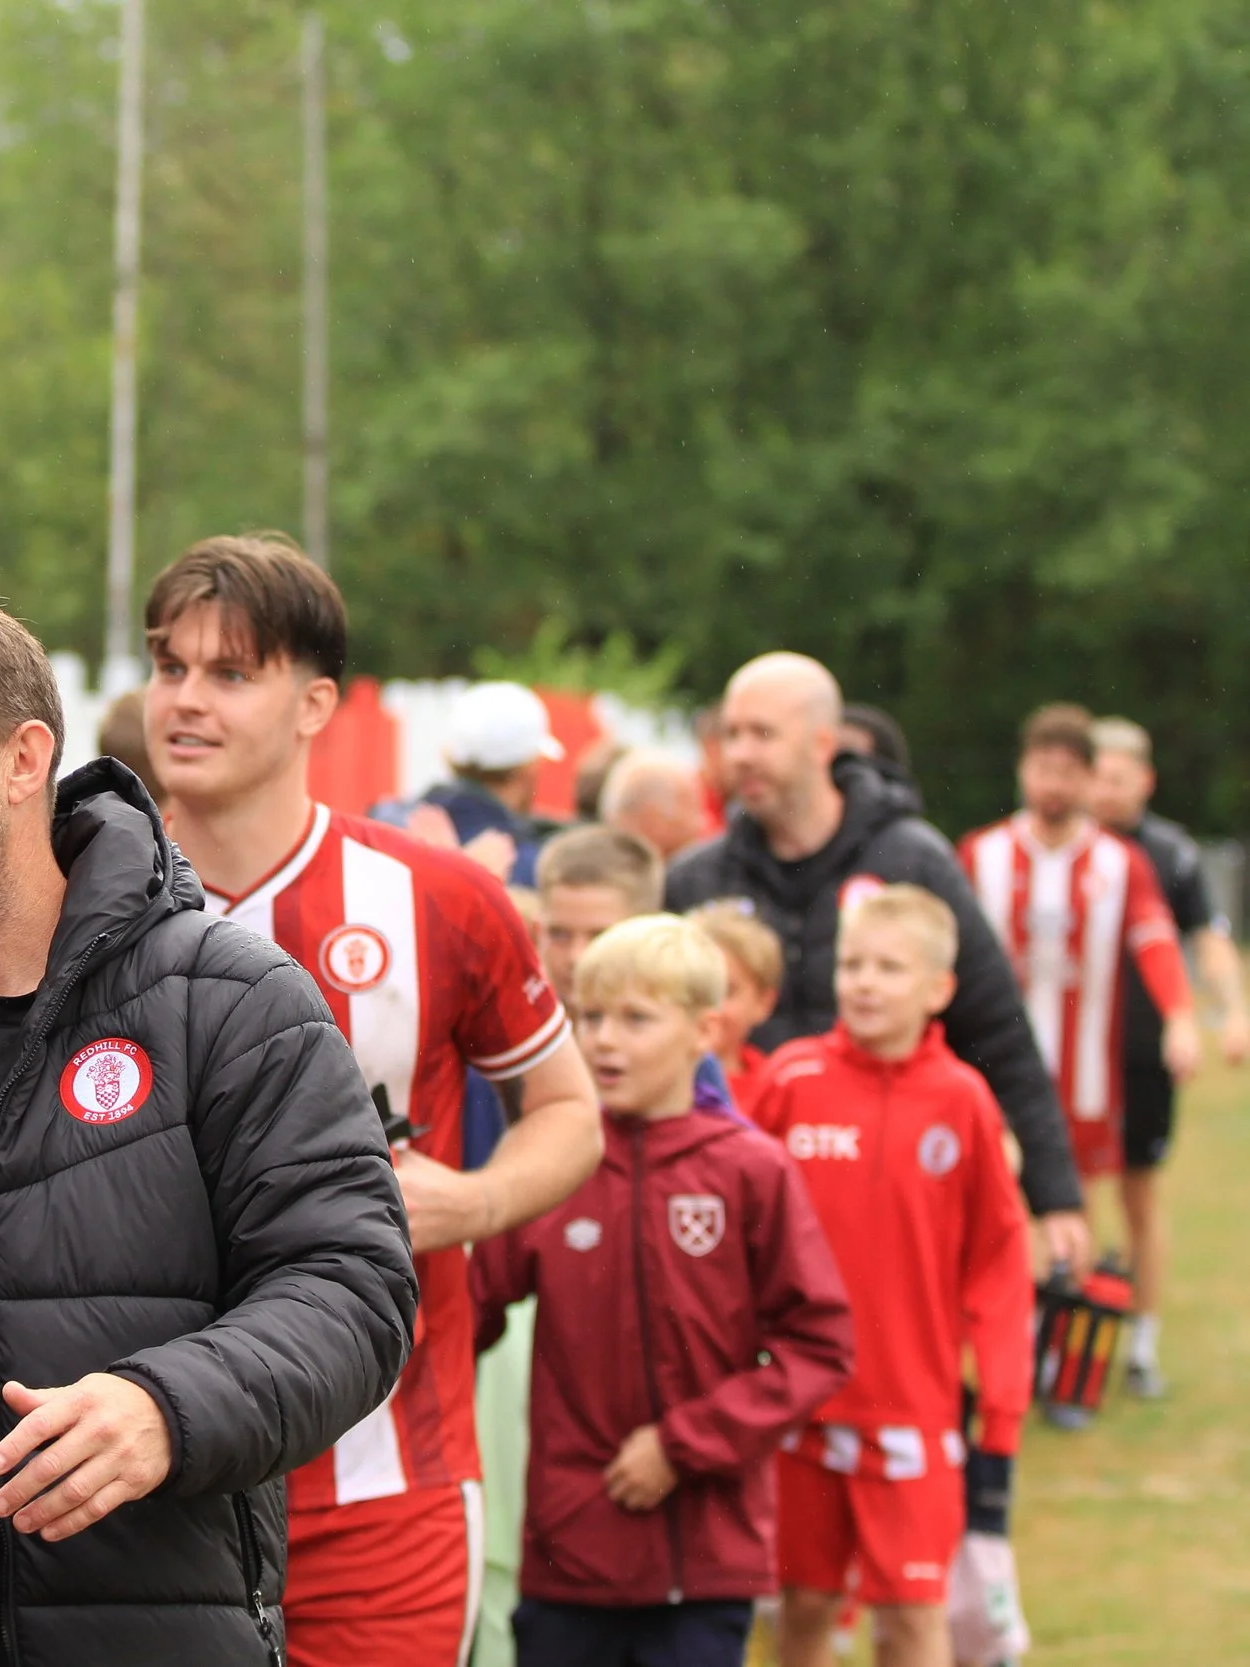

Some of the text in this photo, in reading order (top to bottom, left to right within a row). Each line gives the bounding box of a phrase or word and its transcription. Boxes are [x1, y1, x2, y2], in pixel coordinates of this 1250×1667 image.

[73, 1041, 138, 1066] REDHILL FC
[83, 1103, 134, 1121] EST 1894
